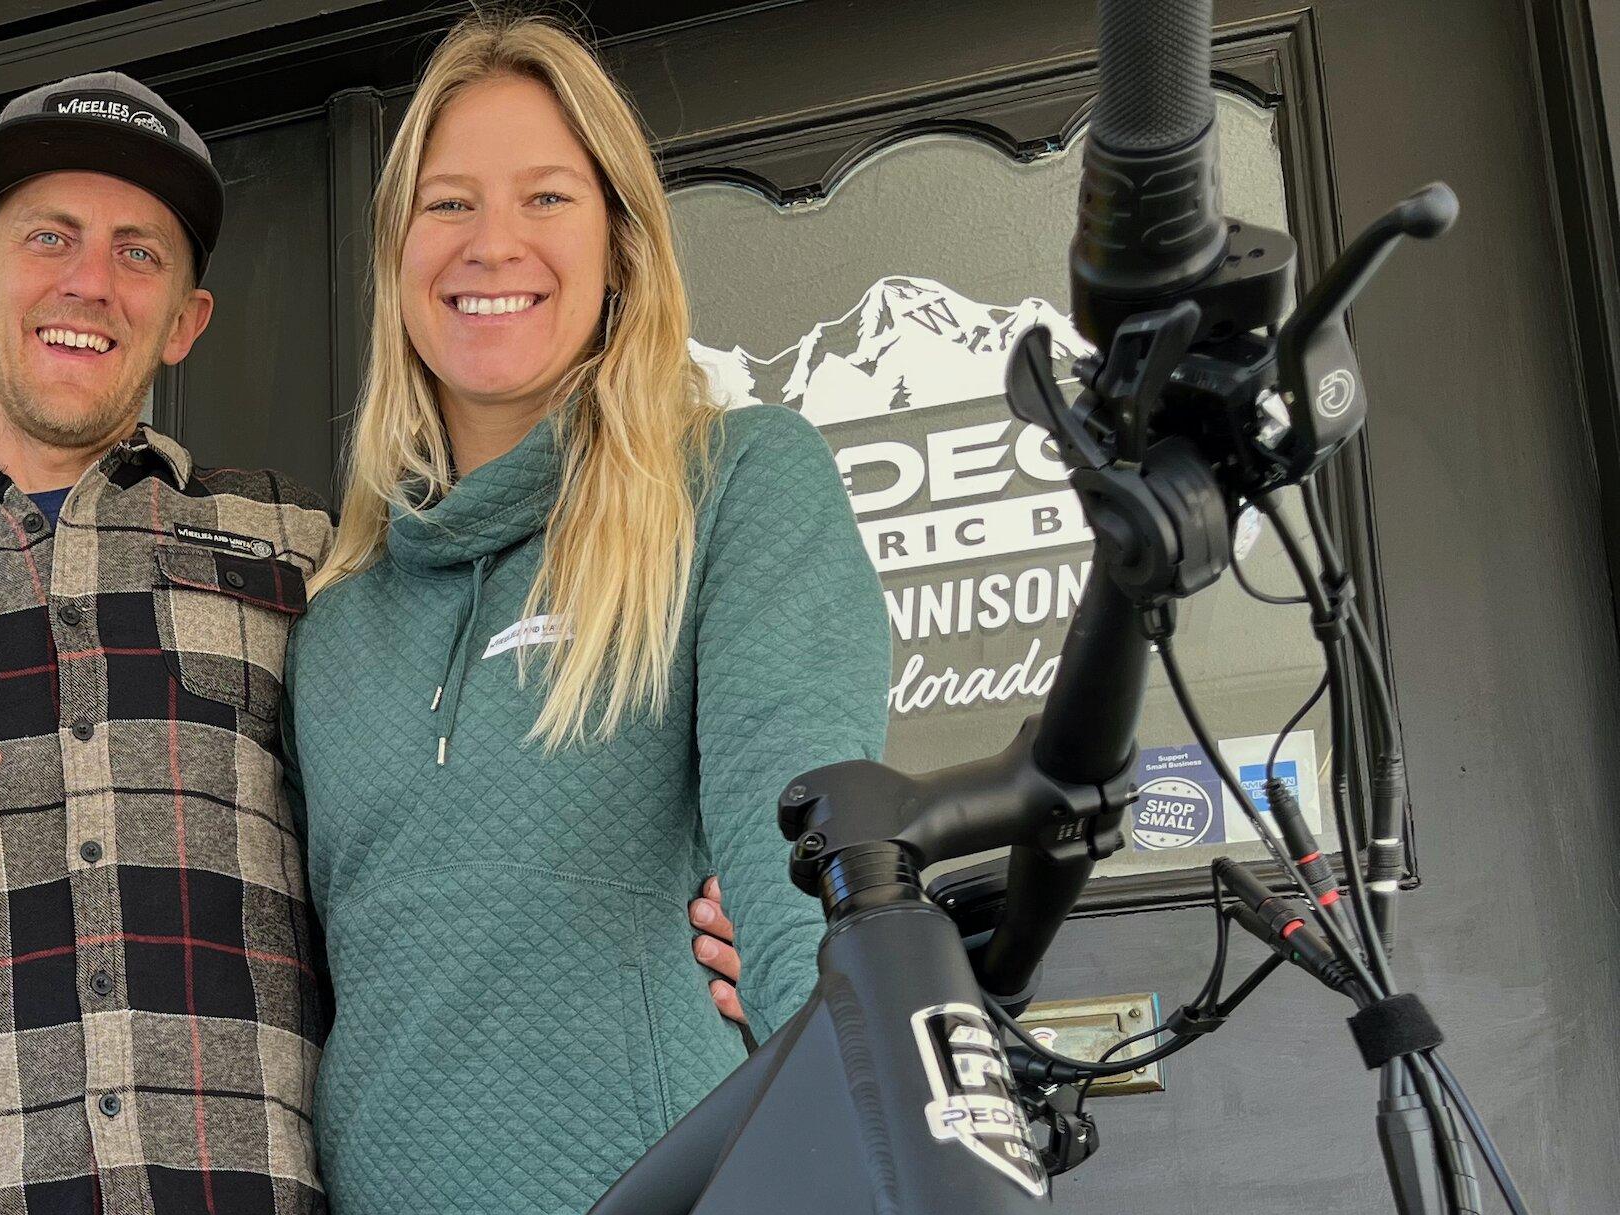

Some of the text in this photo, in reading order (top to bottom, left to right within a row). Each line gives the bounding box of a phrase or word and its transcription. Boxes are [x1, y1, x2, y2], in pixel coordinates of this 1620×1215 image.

[57, 98, 129, 118] WHEELIES
[887, 638, 1063, 714] lorado
[1145, 758, 1202, 772] Small Business
[1157, 751, 1189, 764] Support
[1241, 776, 1295, 791] AMEAN
[1145, 799, 1196, 816] SHOP
[1138, 810, 1196, 831] SMALL
[941, 1106, 1012, 1128] PED
